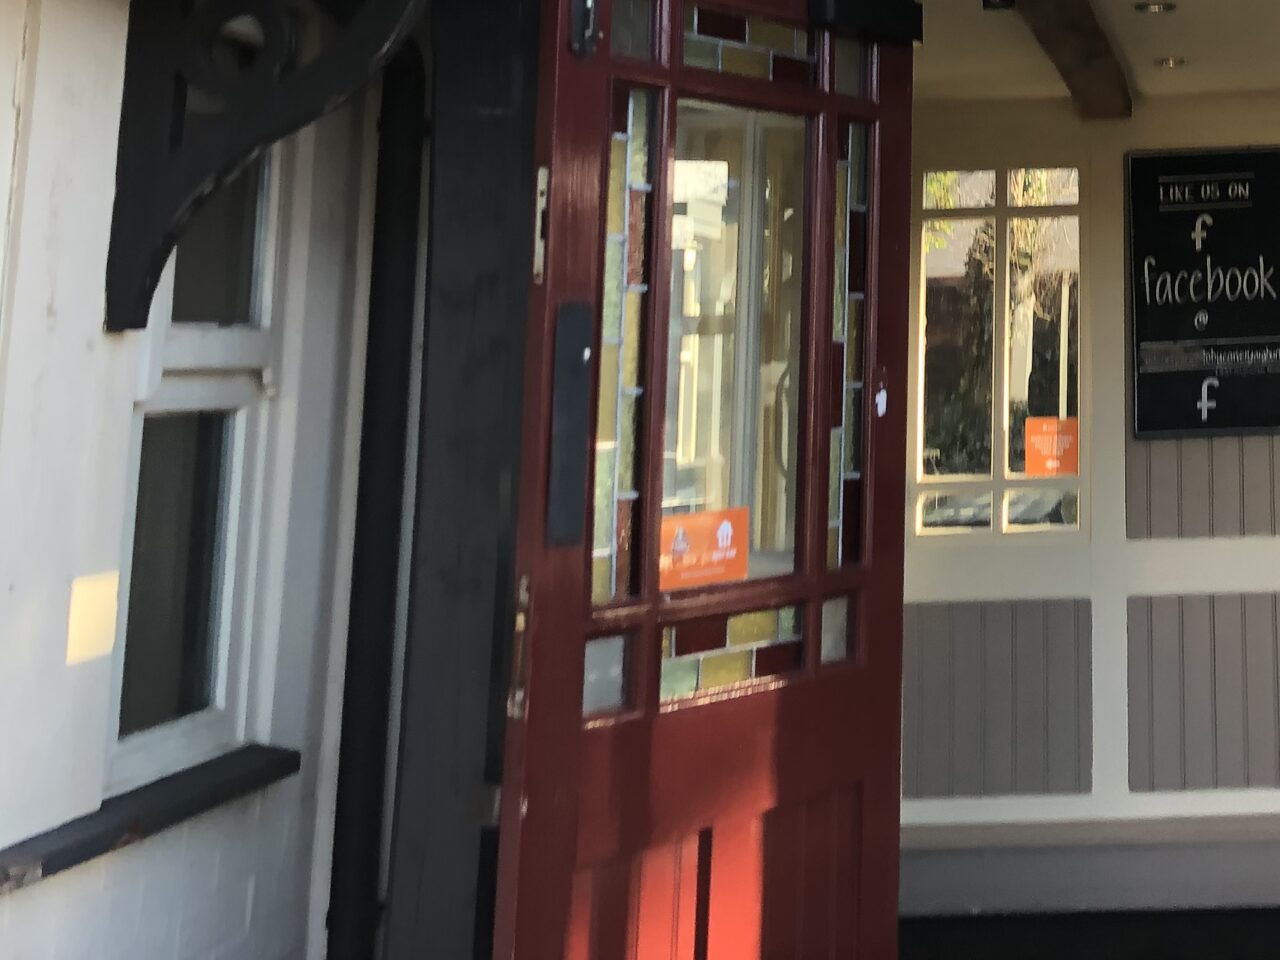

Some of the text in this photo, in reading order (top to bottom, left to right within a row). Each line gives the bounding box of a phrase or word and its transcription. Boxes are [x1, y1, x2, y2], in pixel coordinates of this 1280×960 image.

[1159, 181, 1250, 202] LIKE US ON
[1143, 254, 1278, 306] facebook
